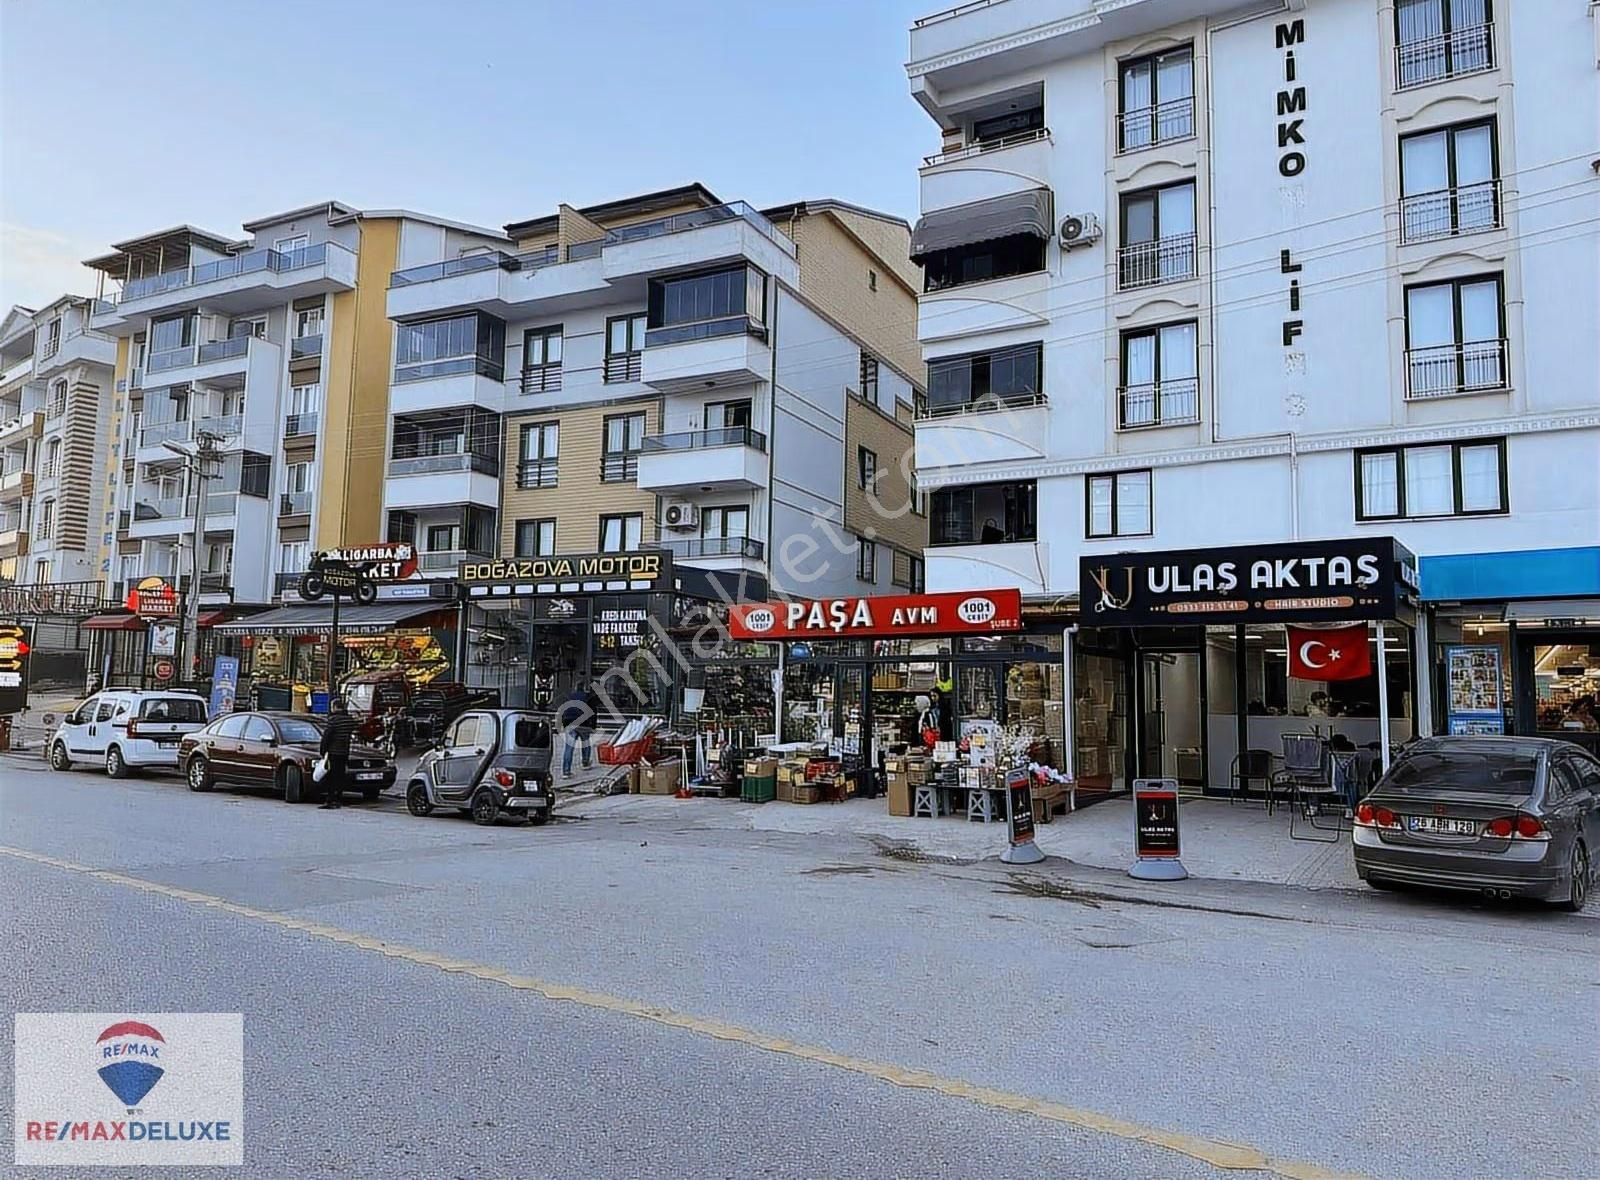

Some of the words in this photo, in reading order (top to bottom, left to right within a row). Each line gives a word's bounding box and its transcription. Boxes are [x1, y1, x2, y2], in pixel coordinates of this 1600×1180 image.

[464, 559, 573, 580] BOĞAZOVA
[579, 556, 660, 576] MOTOR
[323, 575, 356, 587] MOTOR
[963, 602, 990, 613] 1001
[1300, 597, 1339, 608] STUDIO
[750, 613, 770, 623] 1001
[786, 600, 873, 632] PAŞA
[892, 607, 937, 625] AVM
